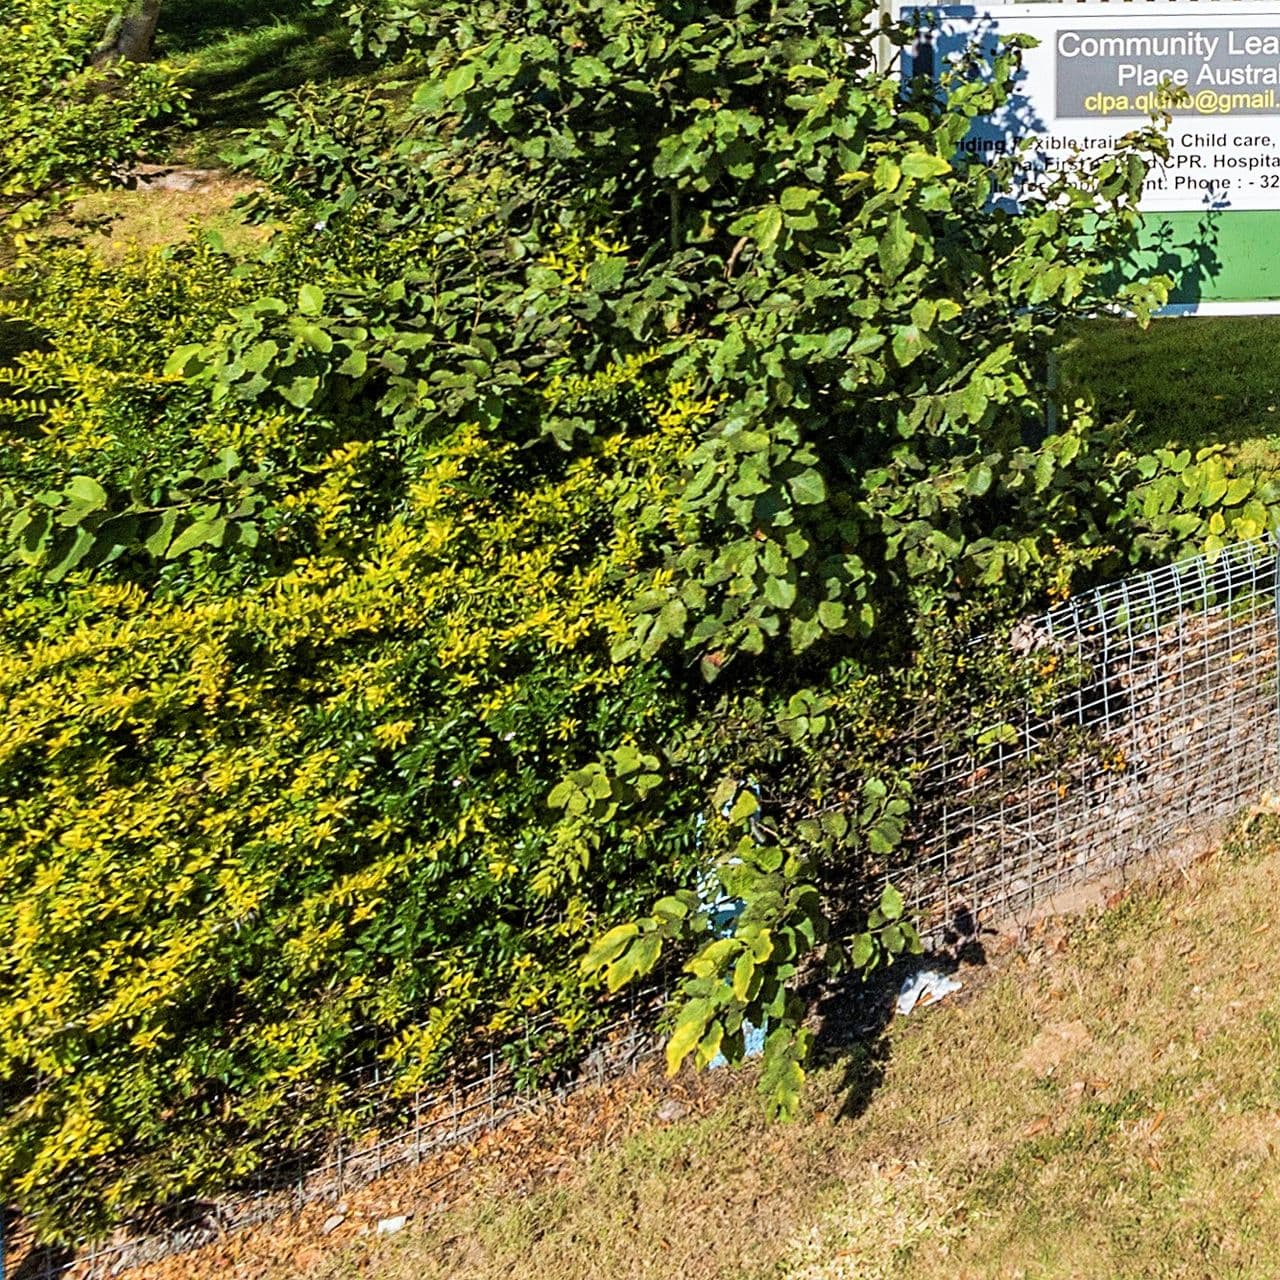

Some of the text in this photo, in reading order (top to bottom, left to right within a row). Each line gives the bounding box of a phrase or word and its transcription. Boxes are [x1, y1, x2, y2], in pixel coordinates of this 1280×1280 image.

[1058, 31, 1219, 61] Community
[1118, 63, 1189, 86] Place
[1181, 133, 1227, 147] Child
[1233, 135, 1275, 149] care,
[1164, 154, 1207, 169] CPR.
[1175, 175, 1231, 190] Phone
